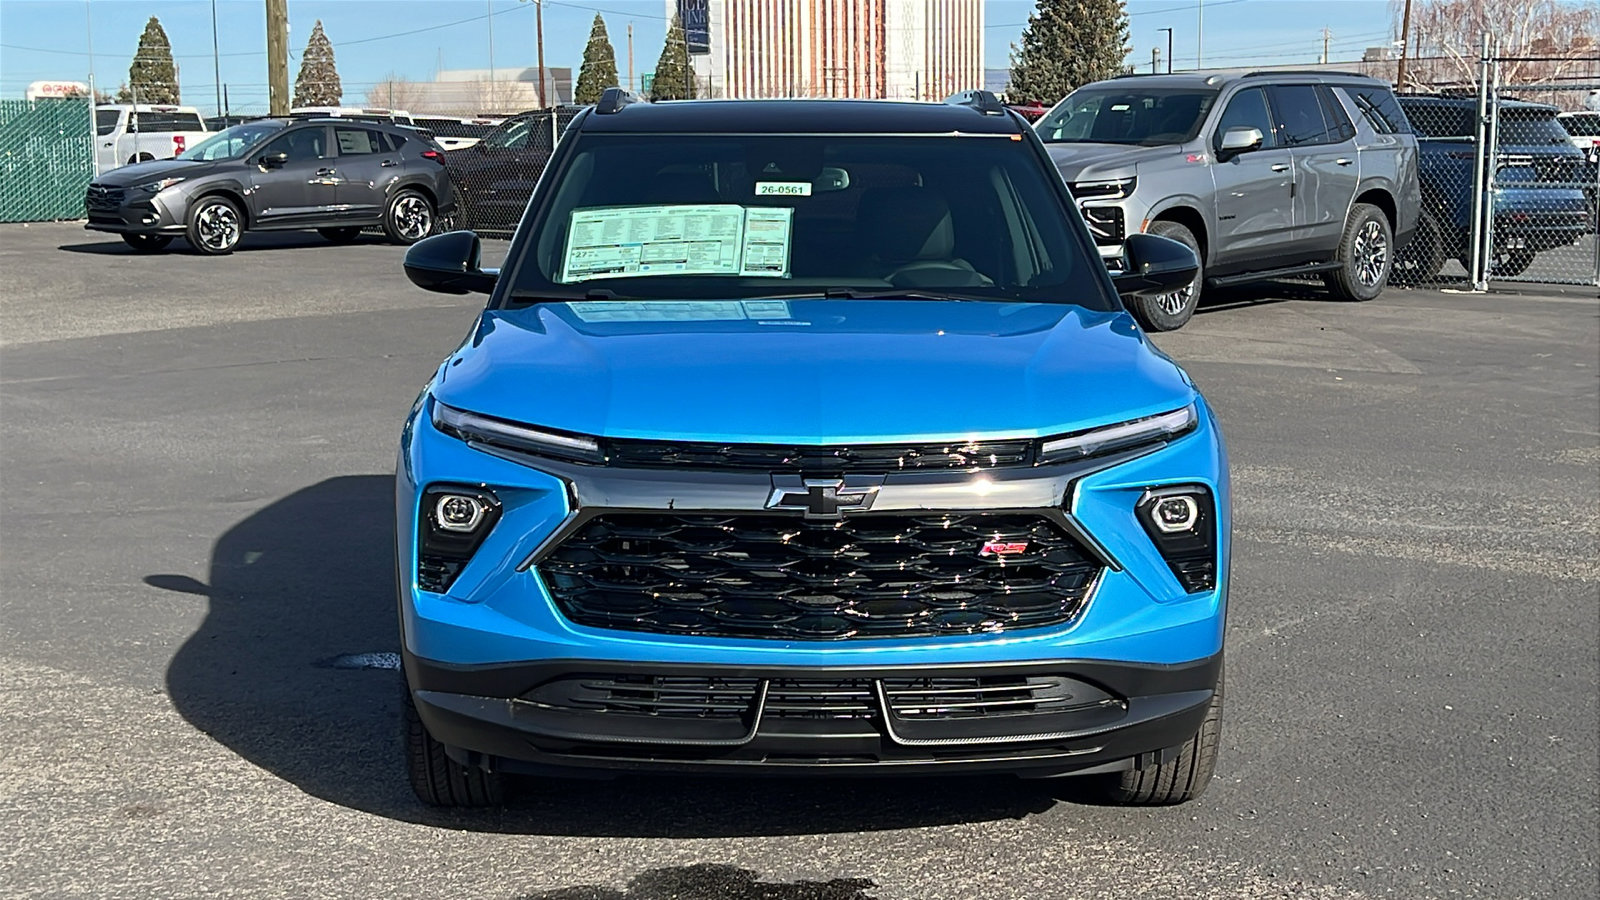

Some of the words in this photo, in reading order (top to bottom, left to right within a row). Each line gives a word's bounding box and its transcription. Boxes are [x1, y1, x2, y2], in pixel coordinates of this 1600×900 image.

[761, 186, 804, 194] 26-0561
[576, 251, 587, 259] 27
[978, 541, 1029, 556] RS
